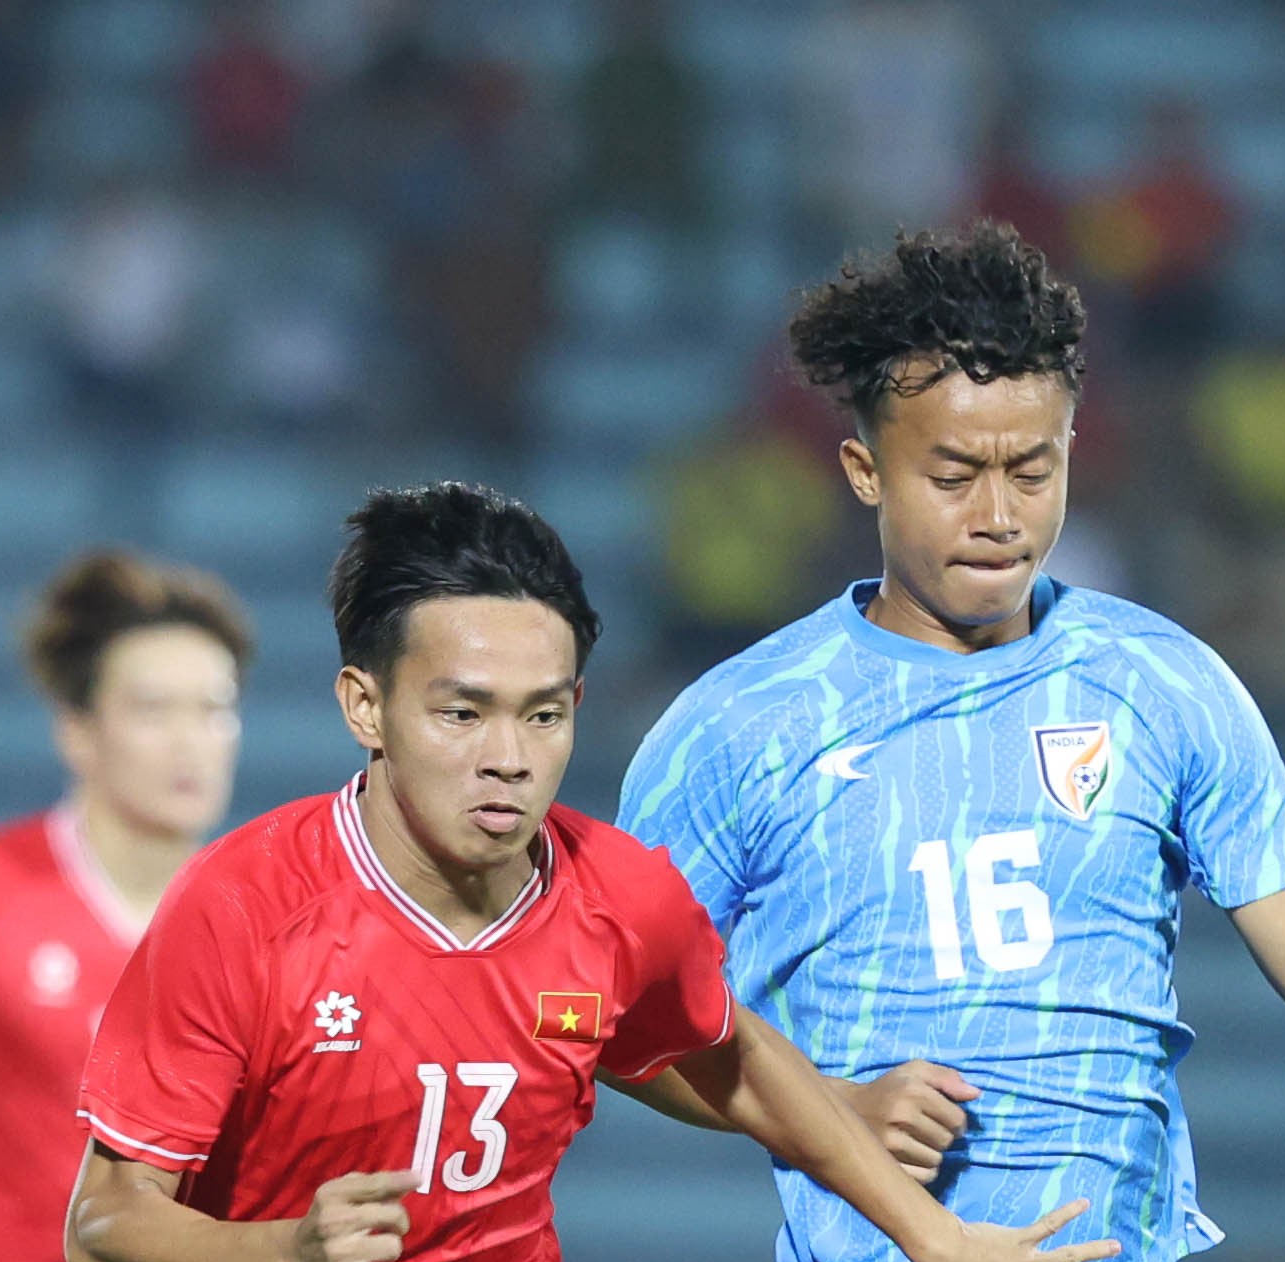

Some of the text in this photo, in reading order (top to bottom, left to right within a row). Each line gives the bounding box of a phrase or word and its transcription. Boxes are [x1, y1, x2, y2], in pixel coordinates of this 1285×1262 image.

[1047, 736, 1087, 748] INDIA
[907, 829, 1055, 981] 16
[413, 1062, 520, 1195] 13
